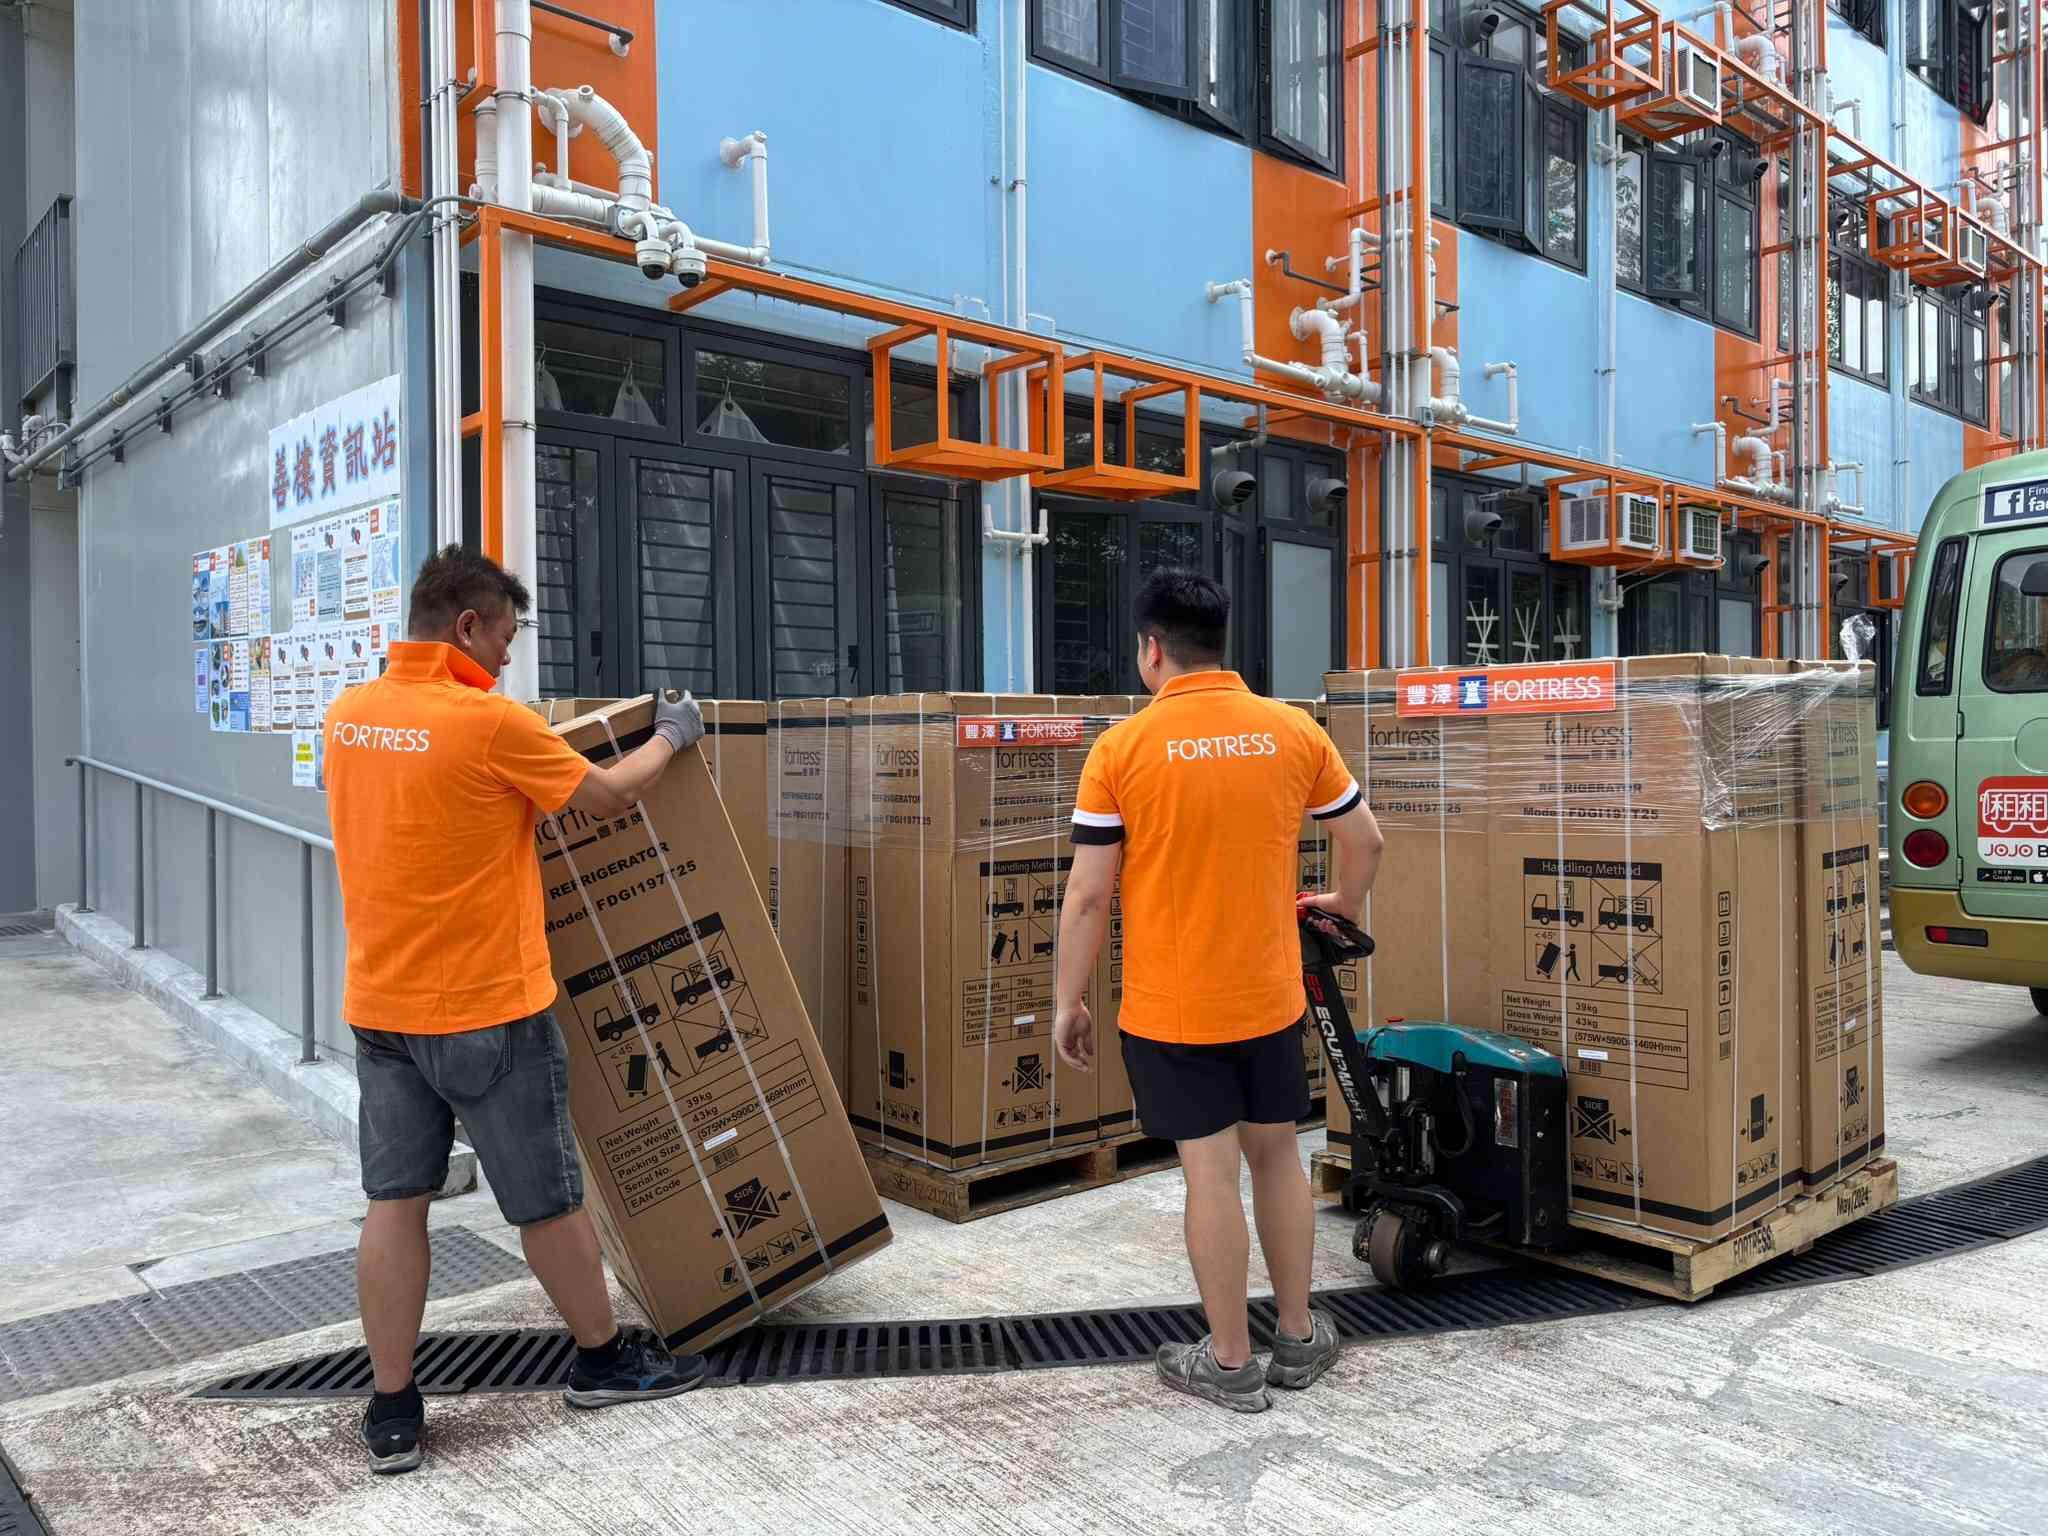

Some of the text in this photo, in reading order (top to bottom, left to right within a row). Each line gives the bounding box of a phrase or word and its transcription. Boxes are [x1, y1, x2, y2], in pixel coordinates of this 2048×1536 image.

[2027, 496, 2048, 512] fa
[1407, 676, 1602, 706] 豐澤 FORTRESS
[332, 721, 431, 752] FORTRESS
[1020, 722, 1078, 739] FORTRESS
[1369, 724, 1441, 746] fortress
[876, 745, 920, 766] fortress
[1167, 733, 1277, 763] FORTRESS
[1984, 844, 2033, 857] JOJO
[549, 841, 671, 901] REFRIGERATOR
[1506, 994, 1520, 1005] Net
[1521, 996, 1552, 1009] Weight
[1507, 1009, 1599, 1029] Gross Weight 43kg
[1507, 1023, 1540, 1036] Packing
[1541, 1026, 1559, 1037] Size
[605, 1090, 713, 1150] Net Weight 39kg
[611, 1104, 719, 1164] Gross Weight 43kg
[617, 1153, 659, 1180] Packing
[659, 1142, 682, 1159] Size
[624, 1171, 654, 1195] Serial
[630, 1178, 682, 1210] EAN Code
[1732, 1225, 1773, 1266] FORTRESS
